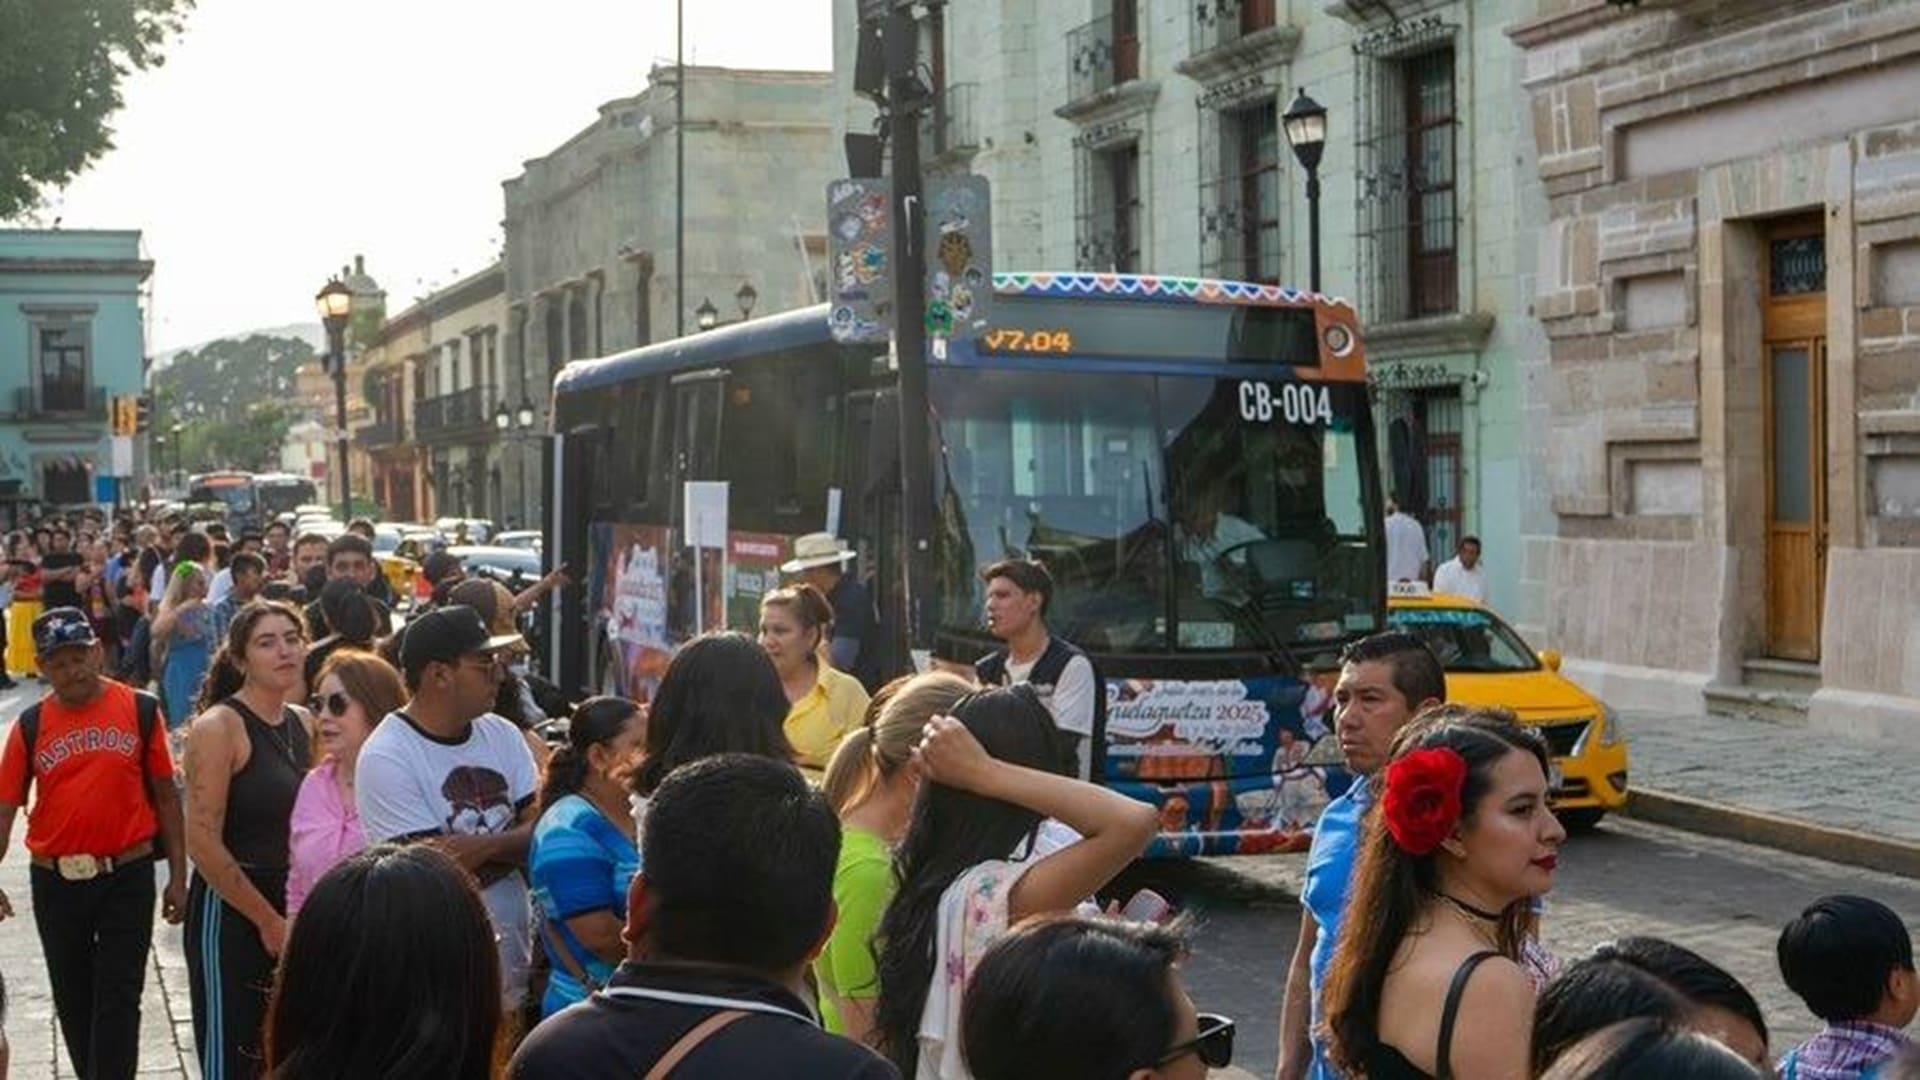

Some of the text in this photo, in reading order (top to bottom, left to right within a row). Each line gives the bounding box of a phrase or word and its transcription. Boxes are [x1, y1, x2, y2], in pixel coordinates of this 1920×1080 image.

[1238, 379, 1333, 426] CB-004
[1216, 702, 1263, 723] 2025
[36, 727, 137, 775] ASTROS
